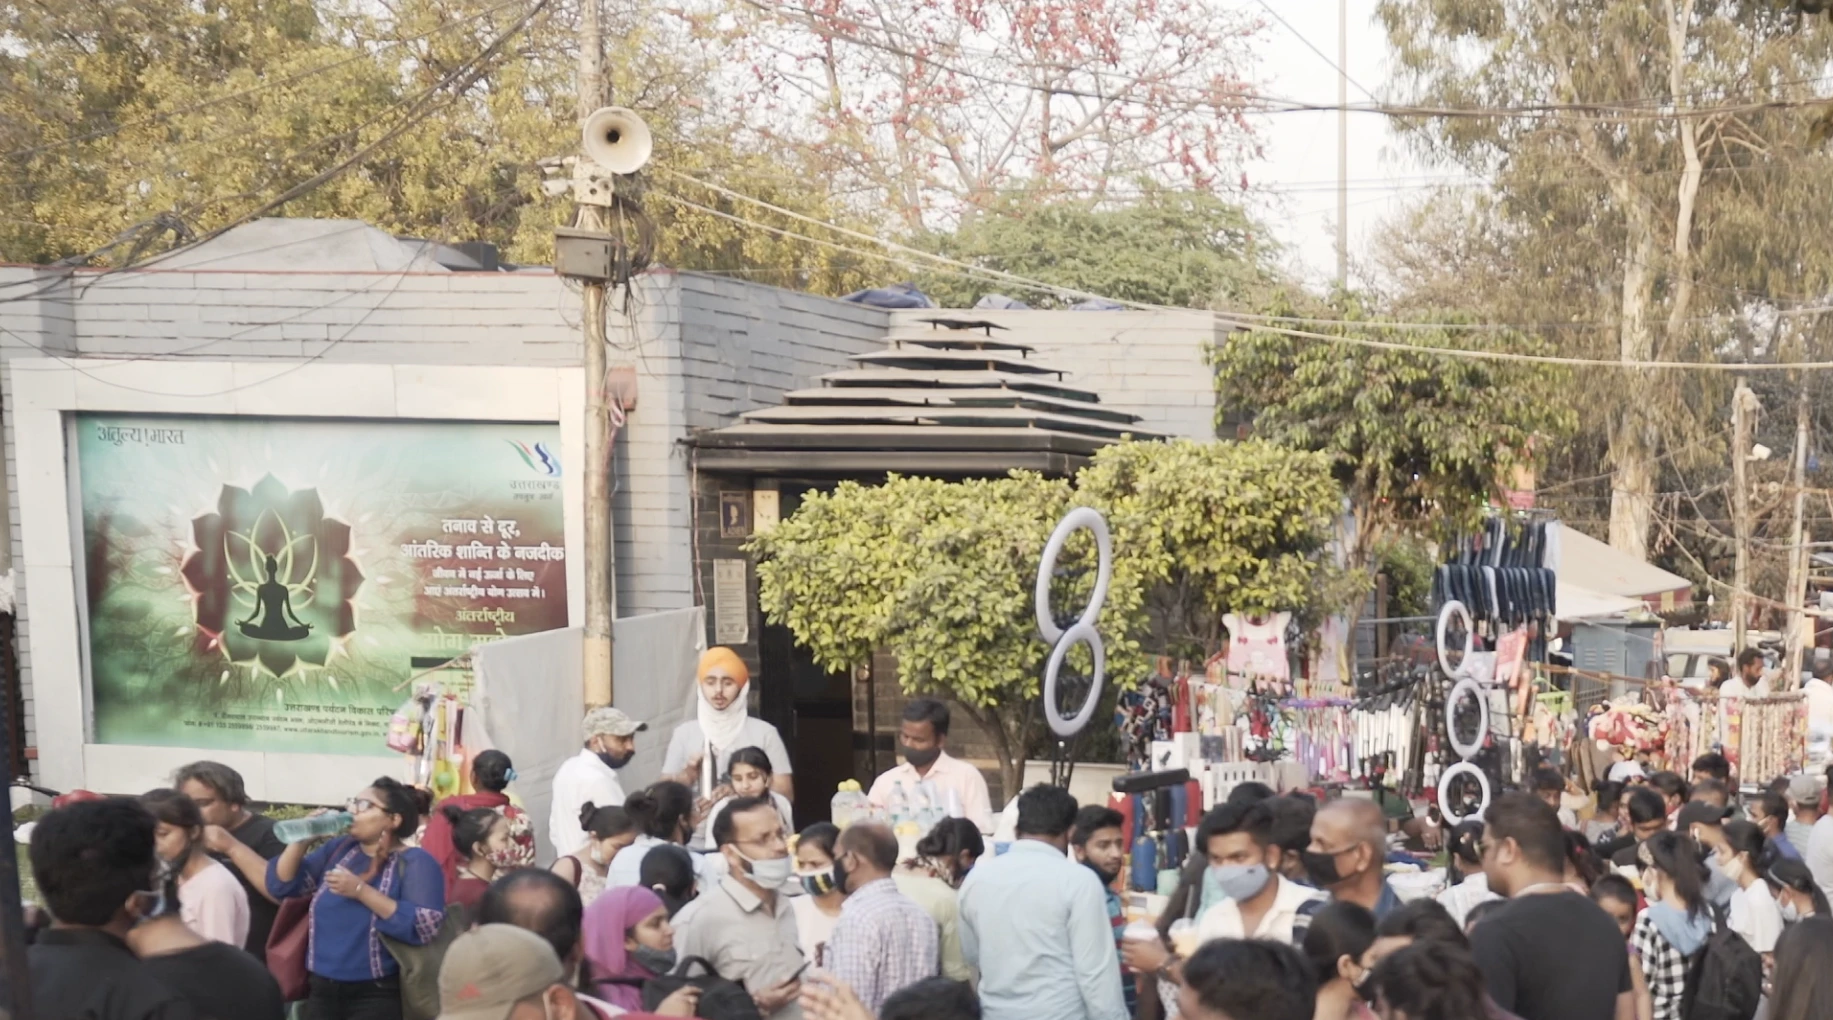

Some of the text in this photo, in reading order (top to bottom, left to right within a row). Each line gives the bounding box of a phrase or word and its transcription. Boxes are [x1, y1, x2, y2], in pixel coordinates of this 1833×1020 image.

[441, 515, 521, 539] तनाव से दूर,
[400, 540, 452, 559] आंतरिक
[496, 541, 511, 560] के
[513, 542, 564, 561] नजदीक
[422, 625, 463, 650] योग
